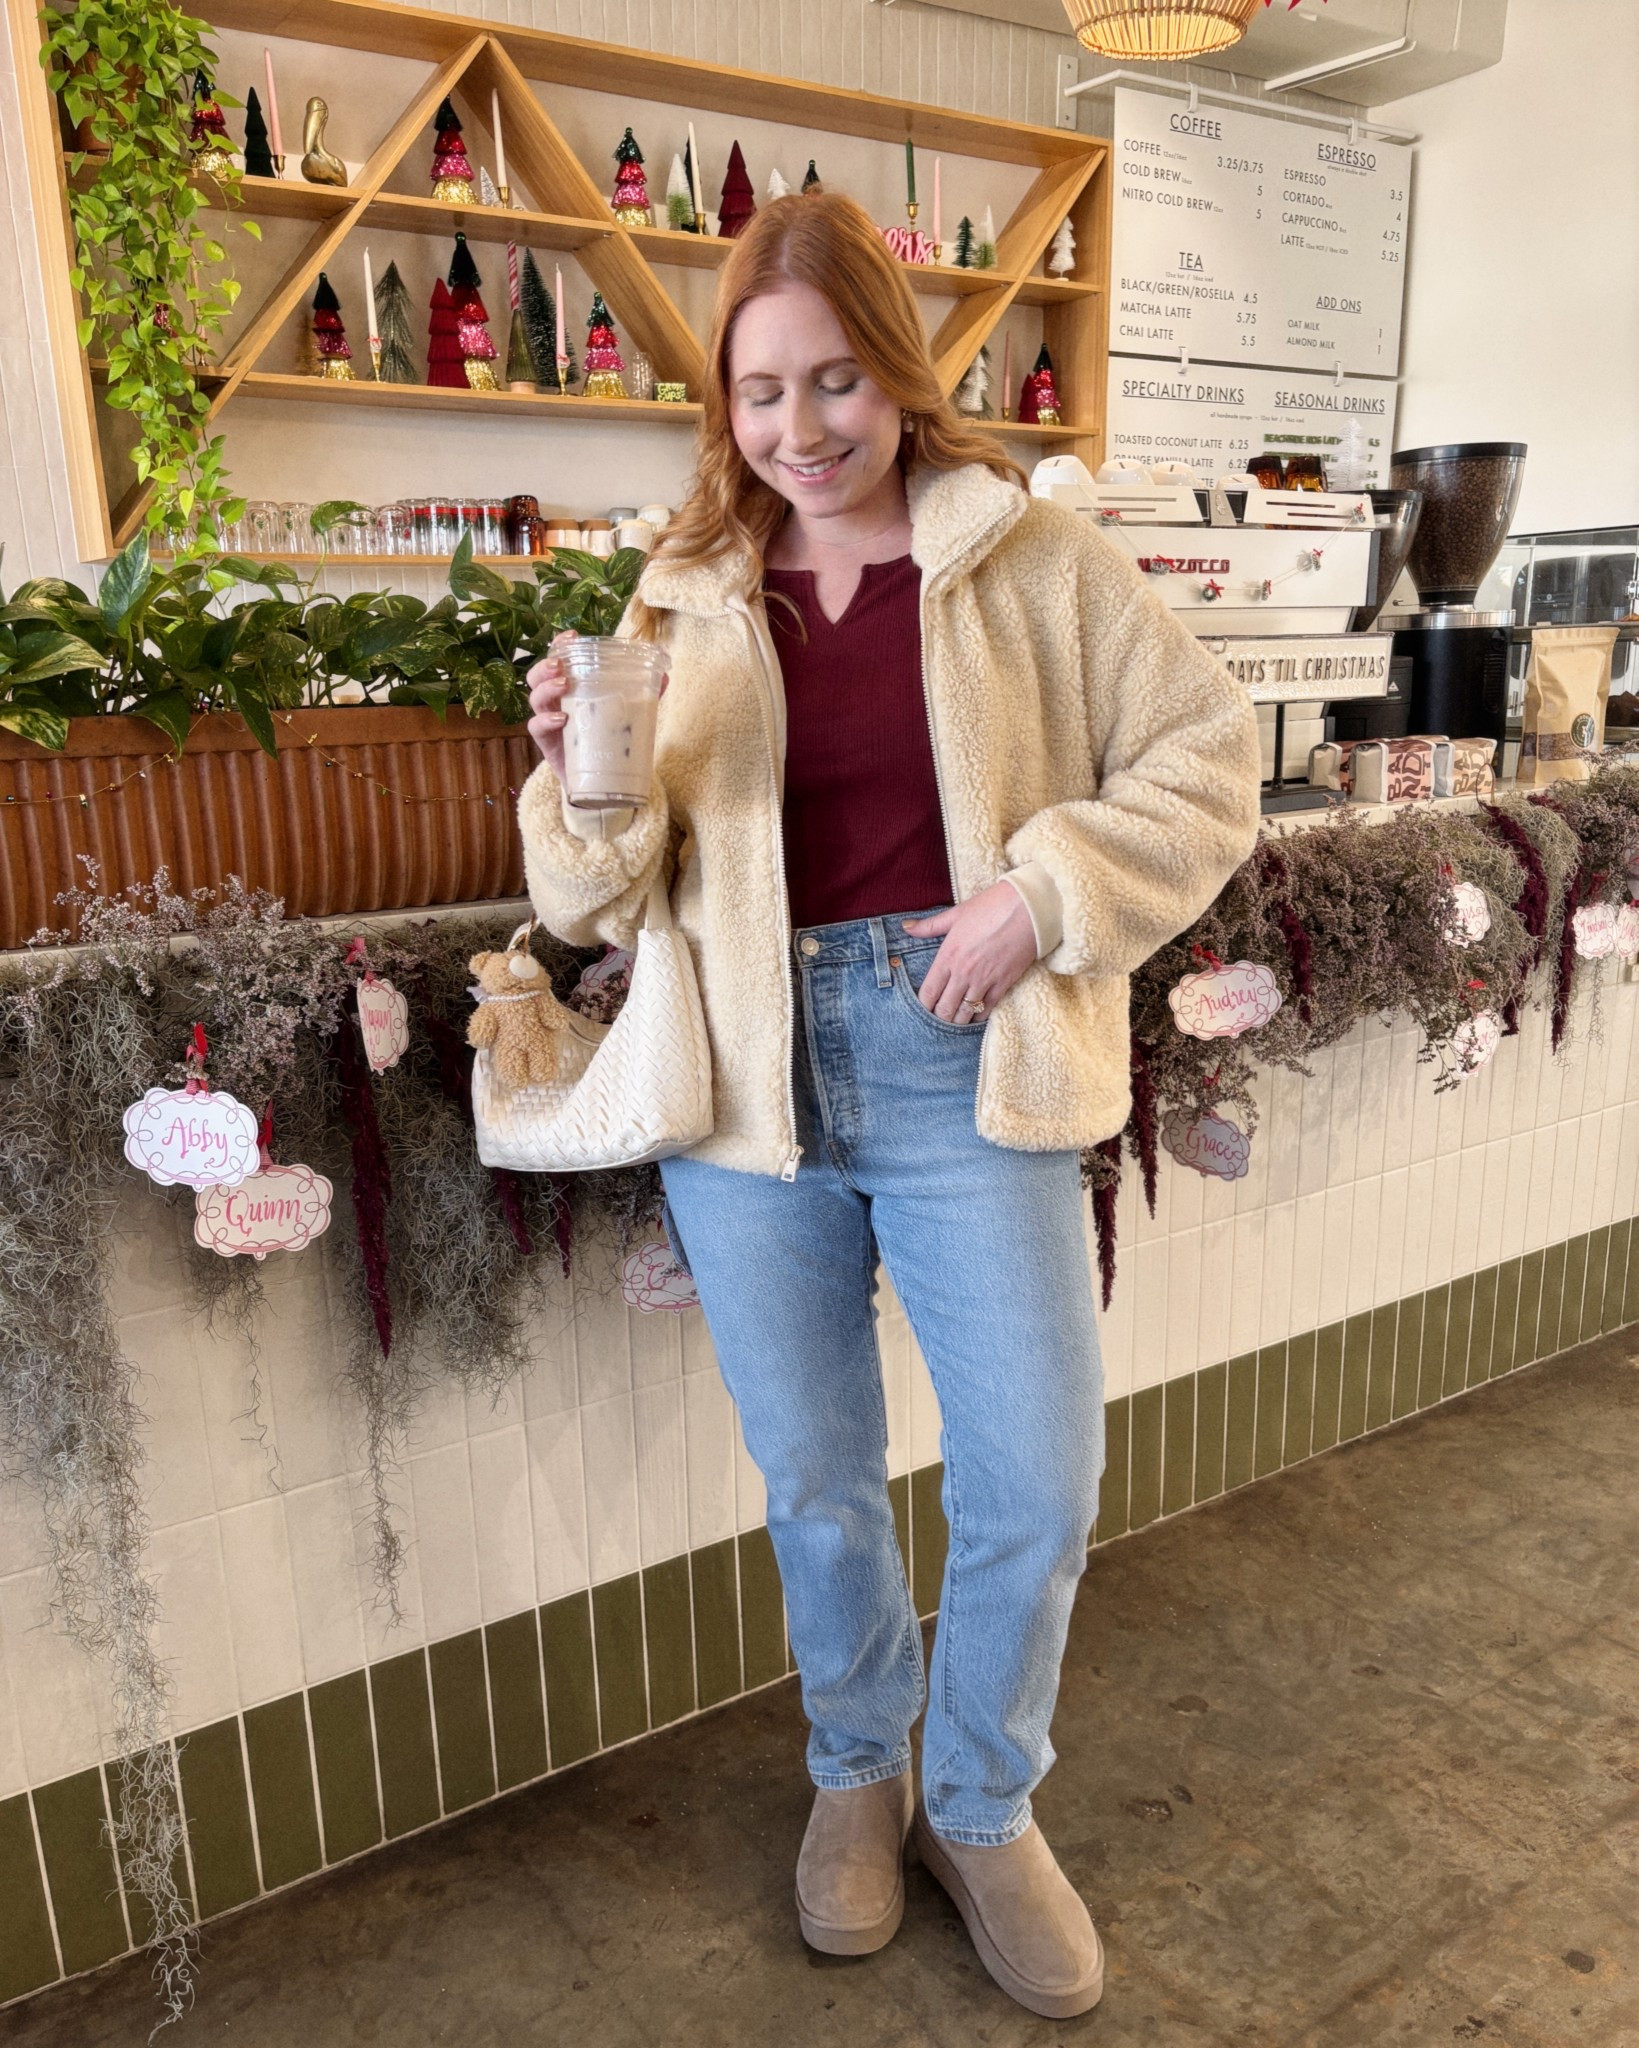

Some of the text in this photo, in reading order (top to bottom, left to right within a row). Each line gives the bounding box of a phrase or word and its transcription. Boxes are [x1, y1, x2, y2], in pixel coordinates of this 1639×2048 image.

[1170, 113, 1222, 137] COFFEE
[1124, 139, 1161, 156] COFFEE
[1217, 156, 1264, 174] 3.25/3.75
[1318, 143, 1376, 169] ESPRESSO
[1123, 162, 1150, 177] COLD
[1154, 168, 1181, 182] BREW
[1257, 185, 1263, 196] 5
[1284, 169, 1403, 201] ESPRESSO 3.5
[1122, 187, 1153, 202] NITRO
[1157, 192, 1183, 207] COLD
[1187, 197, 1213, 211] BREW
[1256, 209, 1262, 219] 5
[1283, 190, 1325, 208] CORTADO
[1396, 212, 1401, 221] 4
[1282, 212, 1338, 232] CAPPUCCINO
[1383, 230, 1400, 242] 4.75
[1179, 252, 1203, 269] TEA
[1281, 234, 1304, 248] LATTE
[1381, 250, 1399, 262] 5.25
[1121, 278, 1258, 304] BLACK/GREEN/ROSELLA 4.5
[1316, 296, 1362, 312] ADD ONS
[1120, 301, 1257, 324] MATCHA LATTE 5.75
[1288, 320, 1302, 328] OAT
[1304, 322, 1320, 330] MILK
[1119, 324, 1255, 347] CHAI LATTE 5.5
[1286, 336, 1317, 347] ALMOND
[1319, 340, 1335, 349] MILK
[1122, 380, 1245, 403] SPECIALTY DRINKS
[1275, 392, 1385, 413] SEASONAL DRINKS
[1114, 434, 1249, 450] TOASTED COCONUT LATTE 6.25
[1191, 457, 1214, 468] LATTE
[1228, 459, 1248, 469] 6.25
[1226, 660, 1266, 683] DAYS
[1303, 656, 1385, 681] CHRISTMAS
[1195, 986, 1258, 1020] Audrey
[162, 1116, 228, 1168] Abby
[1185, 1126, 1234, 1160] Grace
[225, 1190, 302, 1237] Quinn
